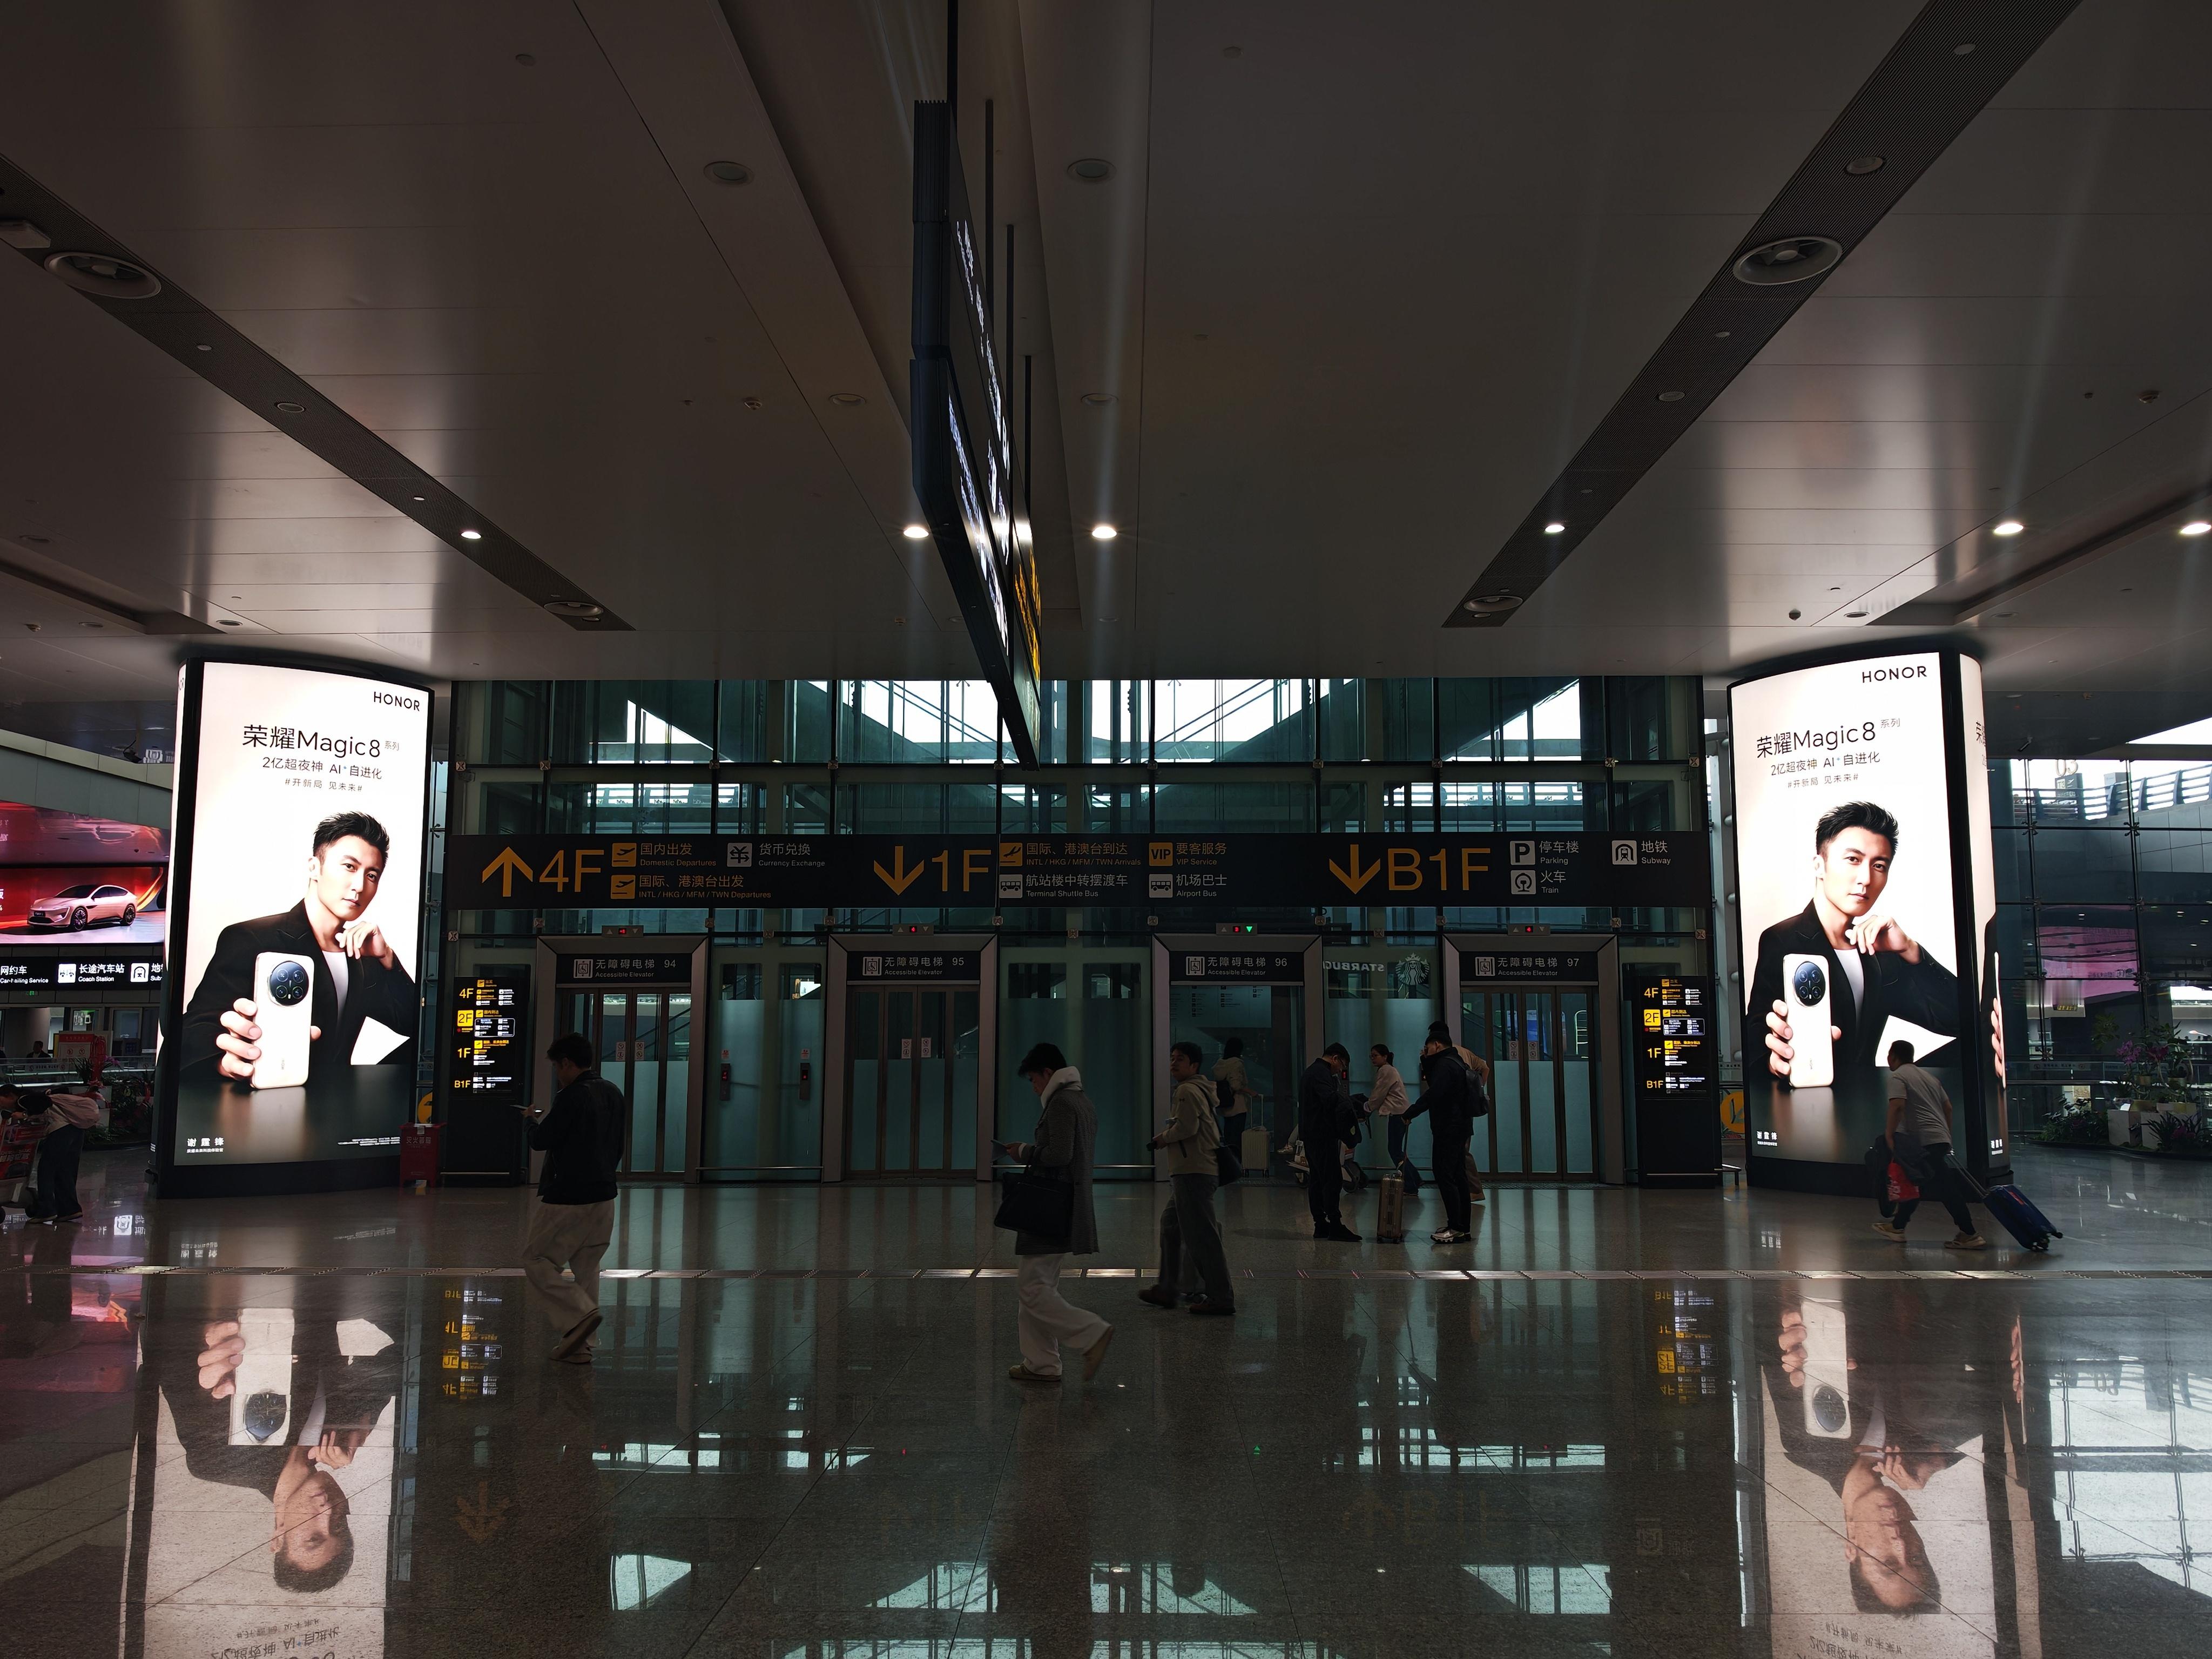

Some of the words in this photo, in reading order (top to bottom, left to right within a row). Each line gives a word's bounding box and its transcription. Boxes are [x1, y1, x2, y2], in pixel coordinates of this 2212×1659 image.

[1862, 666, 1927, 683] HONOR
[374, 691, 420, 711] HONOR
[242, 724, 380, 758] 荣耀Magic8
[384, 740, 400, 751] 系列
[1757, 722, 1876, 758] 荣耀Magic8
[1880, 718, 1900, 728] 系列
[262, 757, 323, 772] 2亿超夜神
[1771, 758, 1817, 775] 2亿超夜神
[640, 842, 692, 855] 国内出发
[759, 842, 811, 855] 货币兑换
[1026, 842, 1128, 855] 国际、港澳台到达
[1176, 842, 1227, 855] 要客服务
[1539, 840, 1580, 854] 停车楼
[1641, 840, 1668, 854] 地铁
[1151, 849, 1171, 860] VIP
[1540, 857, 1568, 865] Parking
[1641, 857, 1671, 865] Subway
[539, 849, 605, 893] 4F
[932, 849, 992, 892] 1F
[1387, 848, 1491, 891] B1F
[639, 875, 744, 888] 国际、港澳台出发
[1026, 874, 1128, 887] 航站楼中转摆渡车
[1176, 874, 1227, 886] 机场巴士
[1540, 870, 1567, 883] 火车
[596, 959, 655, 969] 无障碍电梯
[664, 959, 676, 968] 94
[885, 957, 943, 967] 无障碍电梯
[952, 957, 964, 966] 95
[1208, 957, 1266, 967] 无障碍电梯
[1275, 958, 1287, 966] 96
[1498, 957, 1557, 967] 无障碍电梯
[1567, 958, 1580, 966] 97
[1, 965, 28, 975] 网约车
[79, 964, 124, 974] 长途汽车站
[459, 988, 474, 999] 4F
[1644, 988, 1658, 998] 4F
[458, 1013, 473, 1023] 2F
[1645, 1013, 1659, 1022] 2F
[457, 1048, 471, 1058] 1F
[1647, 1048, 1661, 1058] 1F
